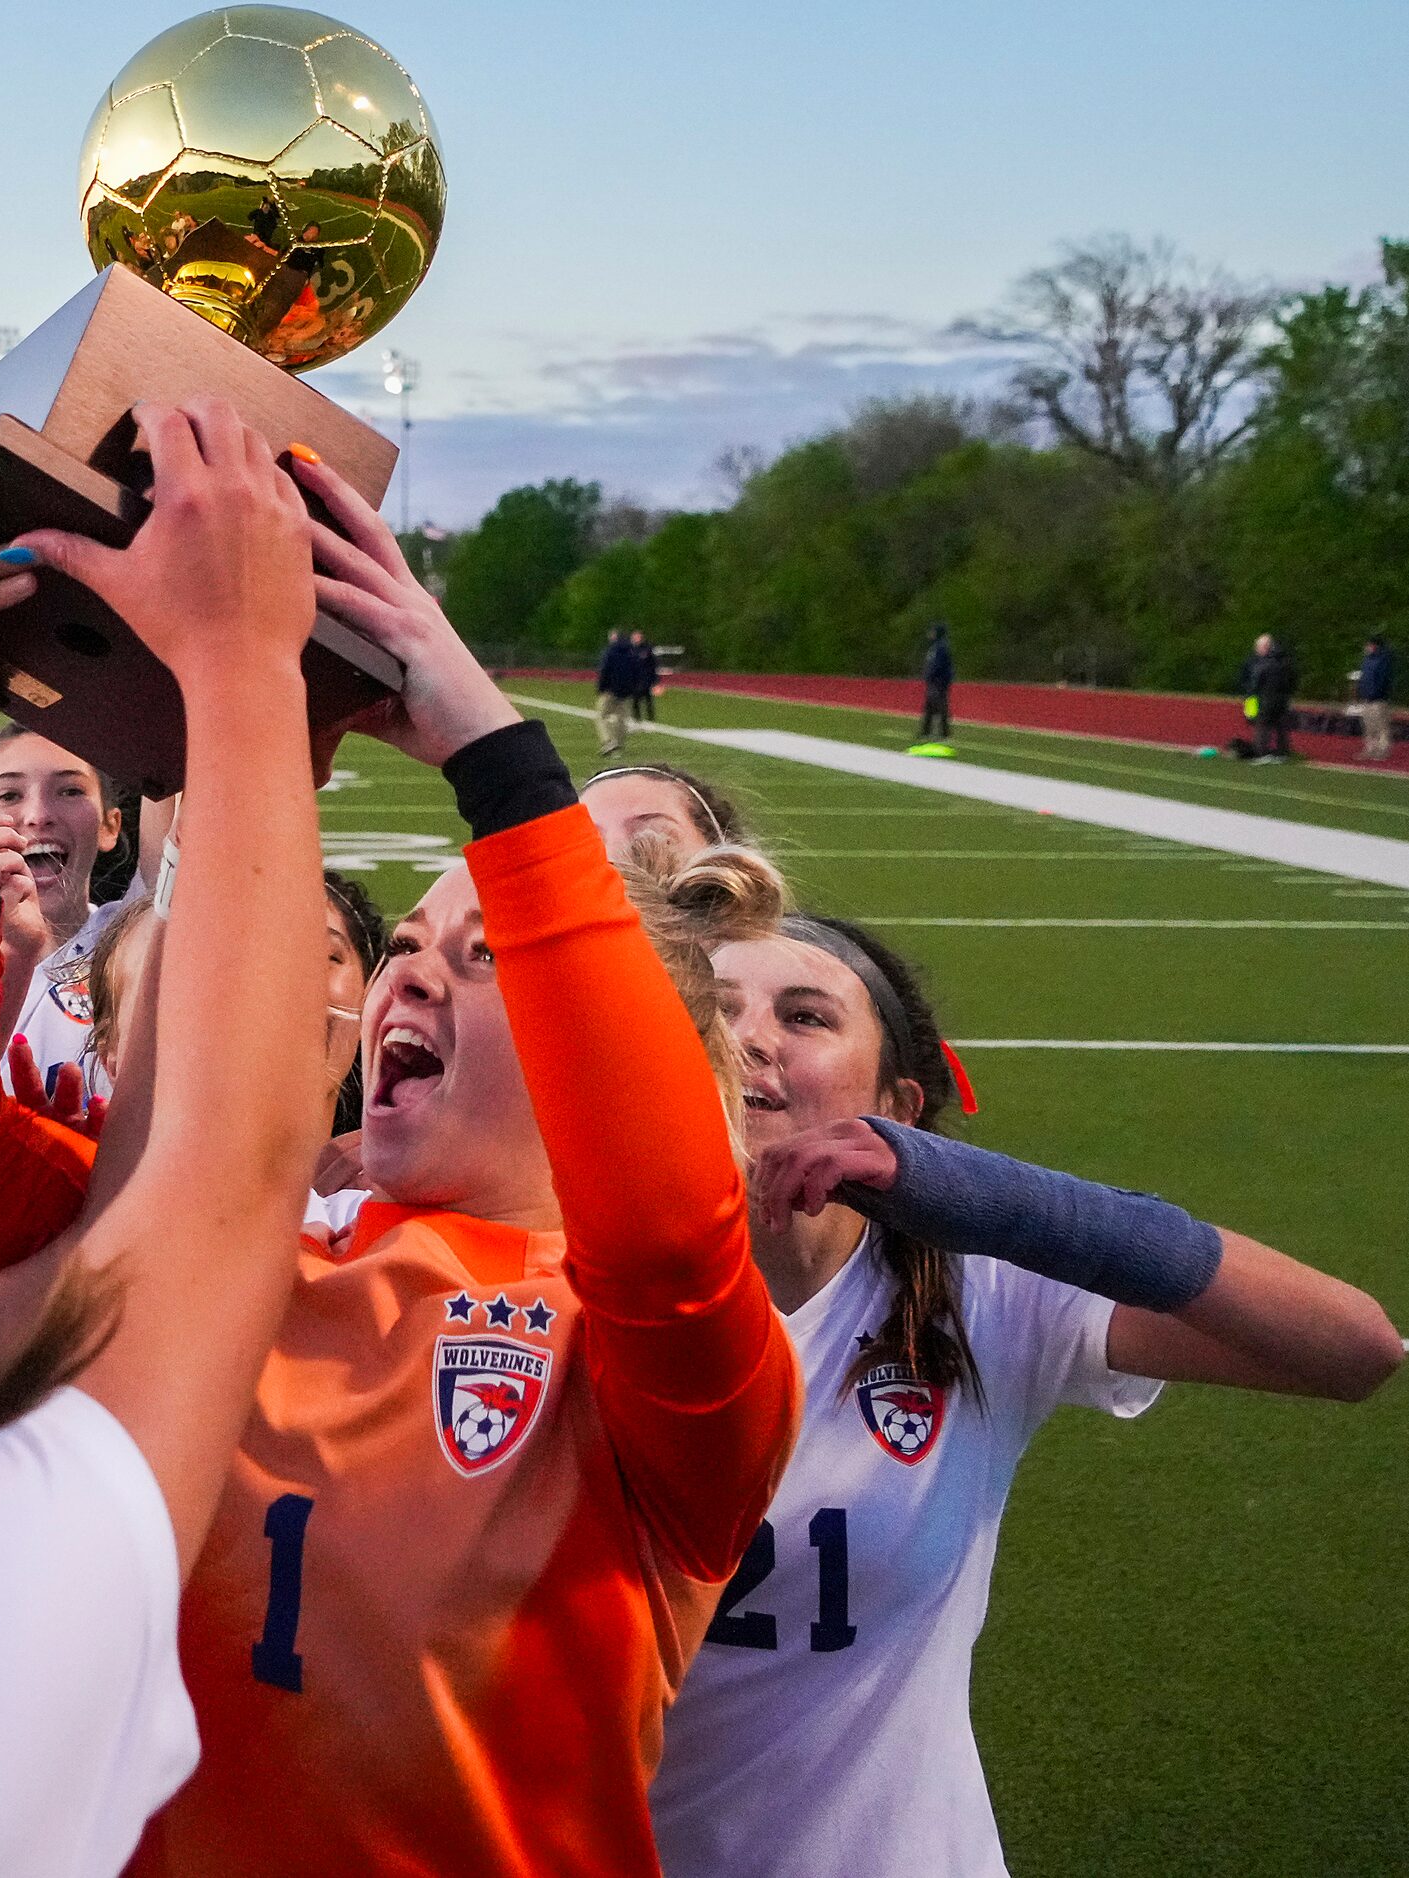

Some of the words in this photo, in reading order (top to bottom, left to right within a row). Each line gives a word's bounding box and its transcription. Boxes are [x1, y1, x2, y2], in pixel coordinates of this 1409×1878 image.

[443, 1349, 544, 1377] WOLVERINES
[251, 1493, 315, 1694] 1
[703, 1507, 858, 1653] 21
